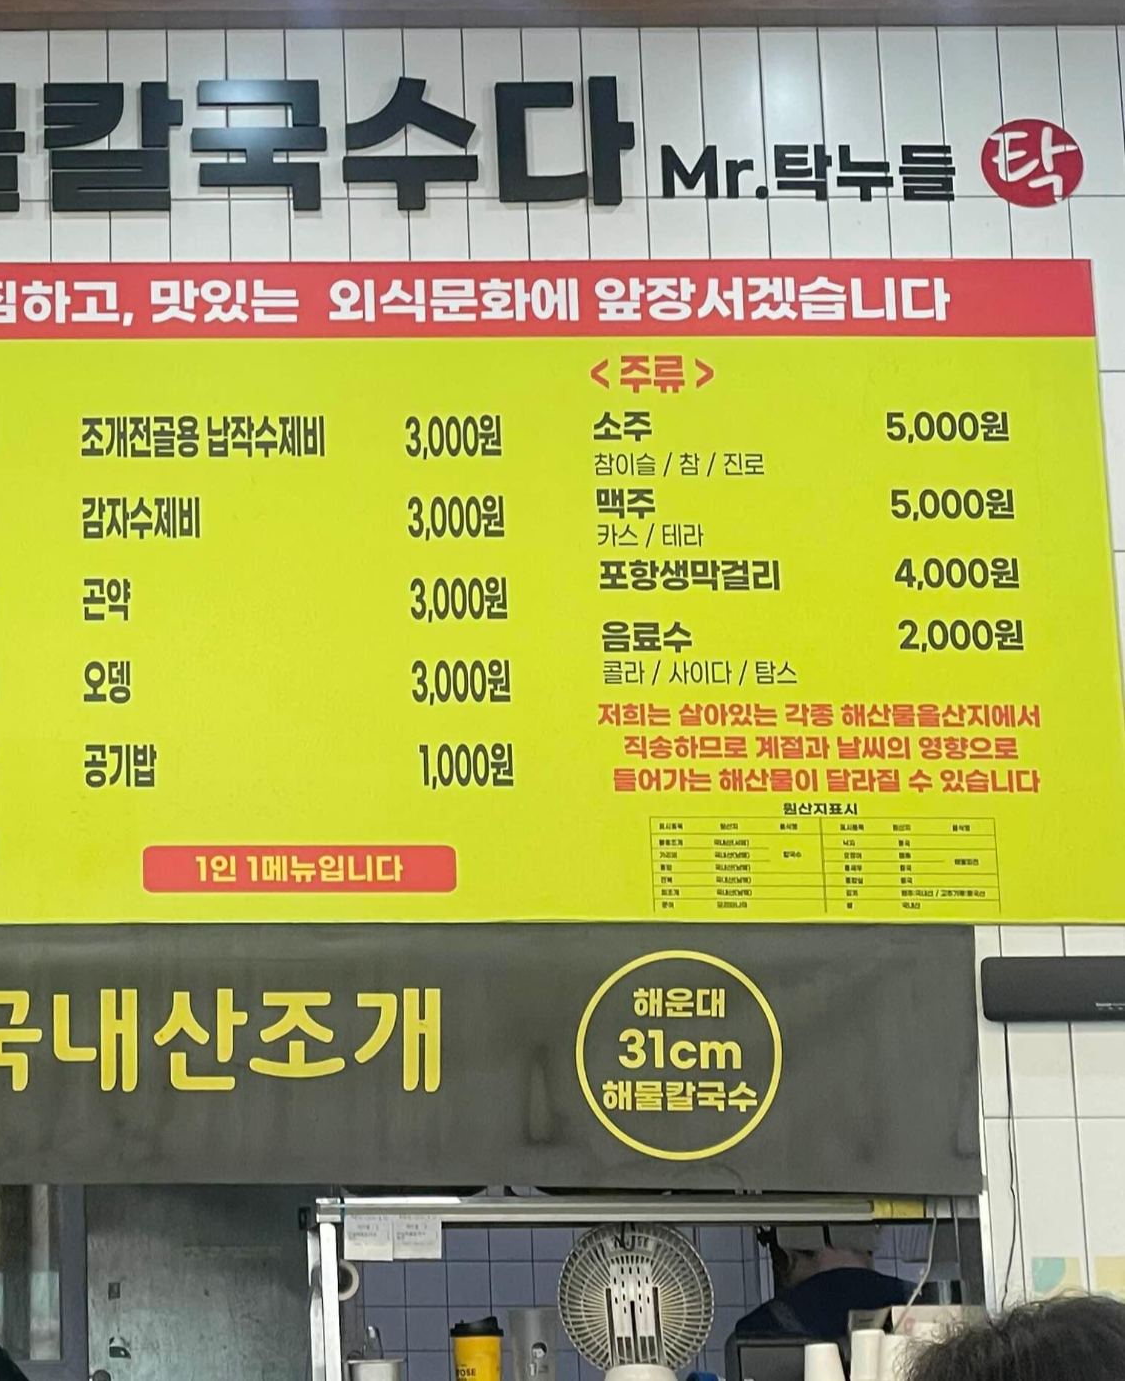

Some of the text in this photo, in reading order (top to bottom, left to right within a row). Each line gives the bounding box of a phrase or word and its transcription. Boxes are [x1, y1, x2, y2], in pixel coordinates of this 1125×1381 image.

[661, 143, 956, 203] Mr.탁누들
[151, 280, 299, 322] 맛있는
[329, 278, 579, 322] 외식문화에
[595, 276, 950, 321] 앞장서겠습니다
[620, 355, 685, 393] 주류
[82, 415, 501, 460] 조개전골용 납작수제비 3,000원
[594, 412, 1009, 443] 소주 5,000원
[595, 453, 655, 475] 참이슬
[680, 453, 699, 475] 참
[724, 453, 764, 475] 진로
[83, 495, 504, 541] 감자수제비 3,000원
[597, 489, 1014, 521] 맥주 5,000원
[598, 524, 638, 547] 카스
[663, 524, 703, 547] 테라
[600, 558, 1019, 591] 포항생막걸리 4,000원
[83, 577, 507, 623] 곤약 3,000원
[602, 620, 1024, 653] 음료수 2,000원
[84, 660, 510, 705] 오뎅 3,000원
[603, 661, 644, 684] 콜라
[669, 661, 732, 684] 사이다
[756, 661, 797, 684] 탐스
[598, 703, 671, 726] 저희는
[679, 704, 777, 726] 살아있는
[785, 704, 833, 727] 각종
[625, 736, 1018, 760] 직송하므로 계절과 날씨의 영향으로
[85, 743, 513, 789] 공기밥 1,000원
[614, 768, 1040, 793] 들어가는 해산물이 달라질 수 있습니다
[784, 803, 857, 815] 원산지표시
[196, 855, 403, 882] 1인 1메뉴입니다
[634, 988, 725, 1017] 해운대
[619, 1029, 741, 1069] 31cm
[601, 1080, 758, 1113] 해물칼국수
